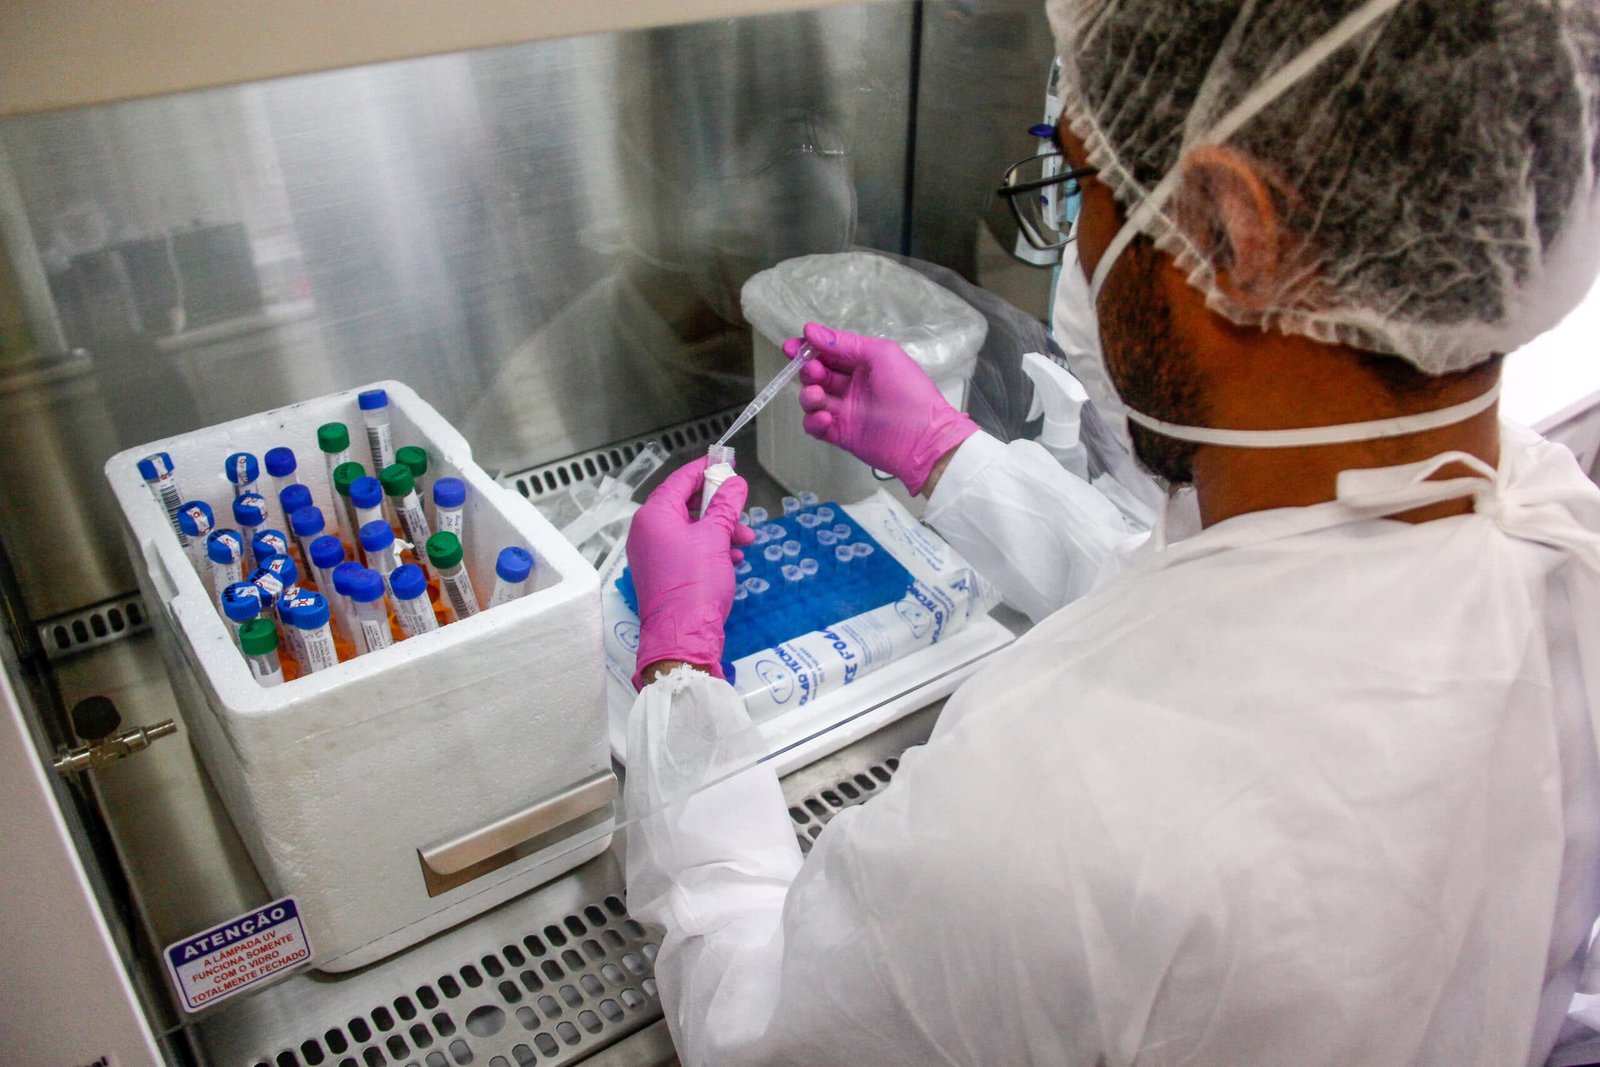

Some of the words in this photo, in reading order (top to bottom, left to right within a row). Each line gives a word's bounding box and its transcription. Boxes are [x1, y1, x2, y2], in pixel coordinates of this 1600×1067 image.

[184, 907, 286, 960] ATENÇÃO
[192, 955, 245, 983] FUNCIONA
[246, 933, 294, 960] SOMENTE
[204, 959, 212, 967] A
[213, 938, 262, 963] LÂMPADA
[263, 930, 276, 942] UV
[192, 970, 257, 1004] TOTALMENTE
[259, 949, 306, 974] FECHADO
[213, 970, 237, 984] COM
[239, 964, 247, 973] O
[249, 950, 279, 968] VIDRO
